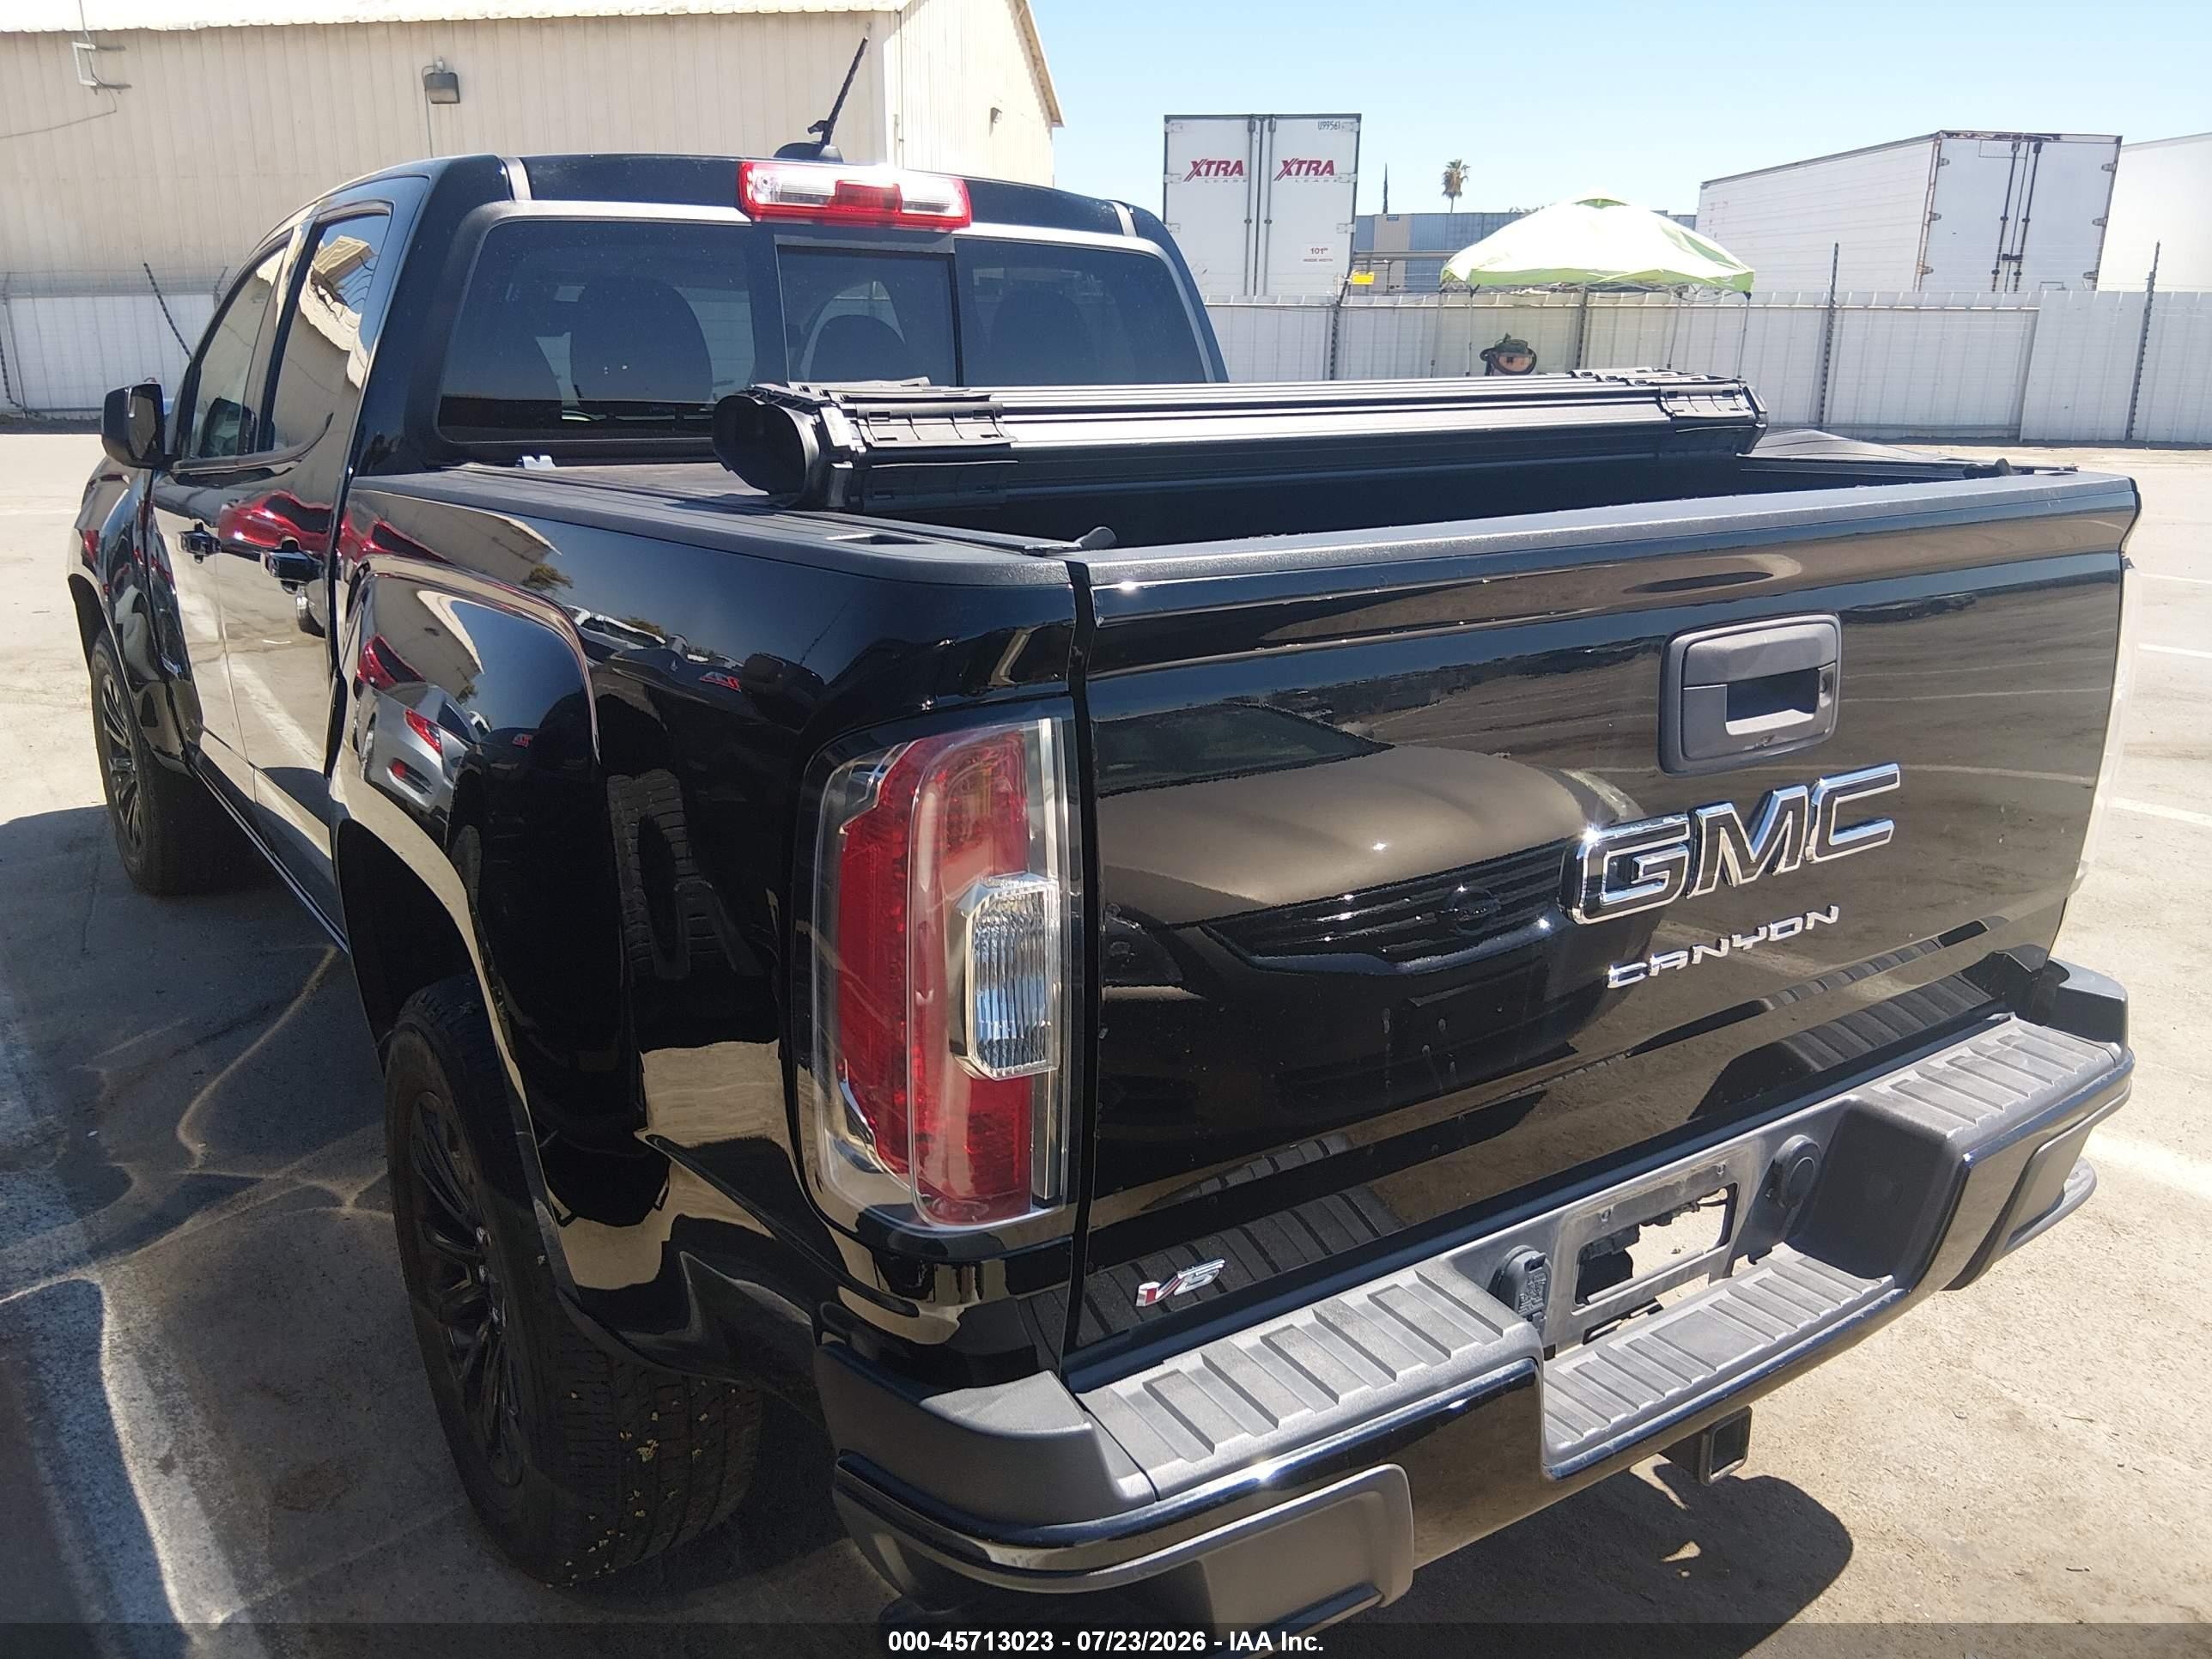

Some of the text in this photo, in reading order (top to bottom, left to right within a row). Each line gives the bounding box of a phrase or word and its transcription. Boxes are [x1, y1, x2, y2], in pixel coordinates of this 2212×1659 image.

[1183, 159, 1244, 182] XTRA
[1273, 158, 1334, 182] XTRA
[1558, 763, 1901, 926] GMC
[1607, 904, 1840, 989] CANYON
[1135, 1257, 1226, 1307] V6
